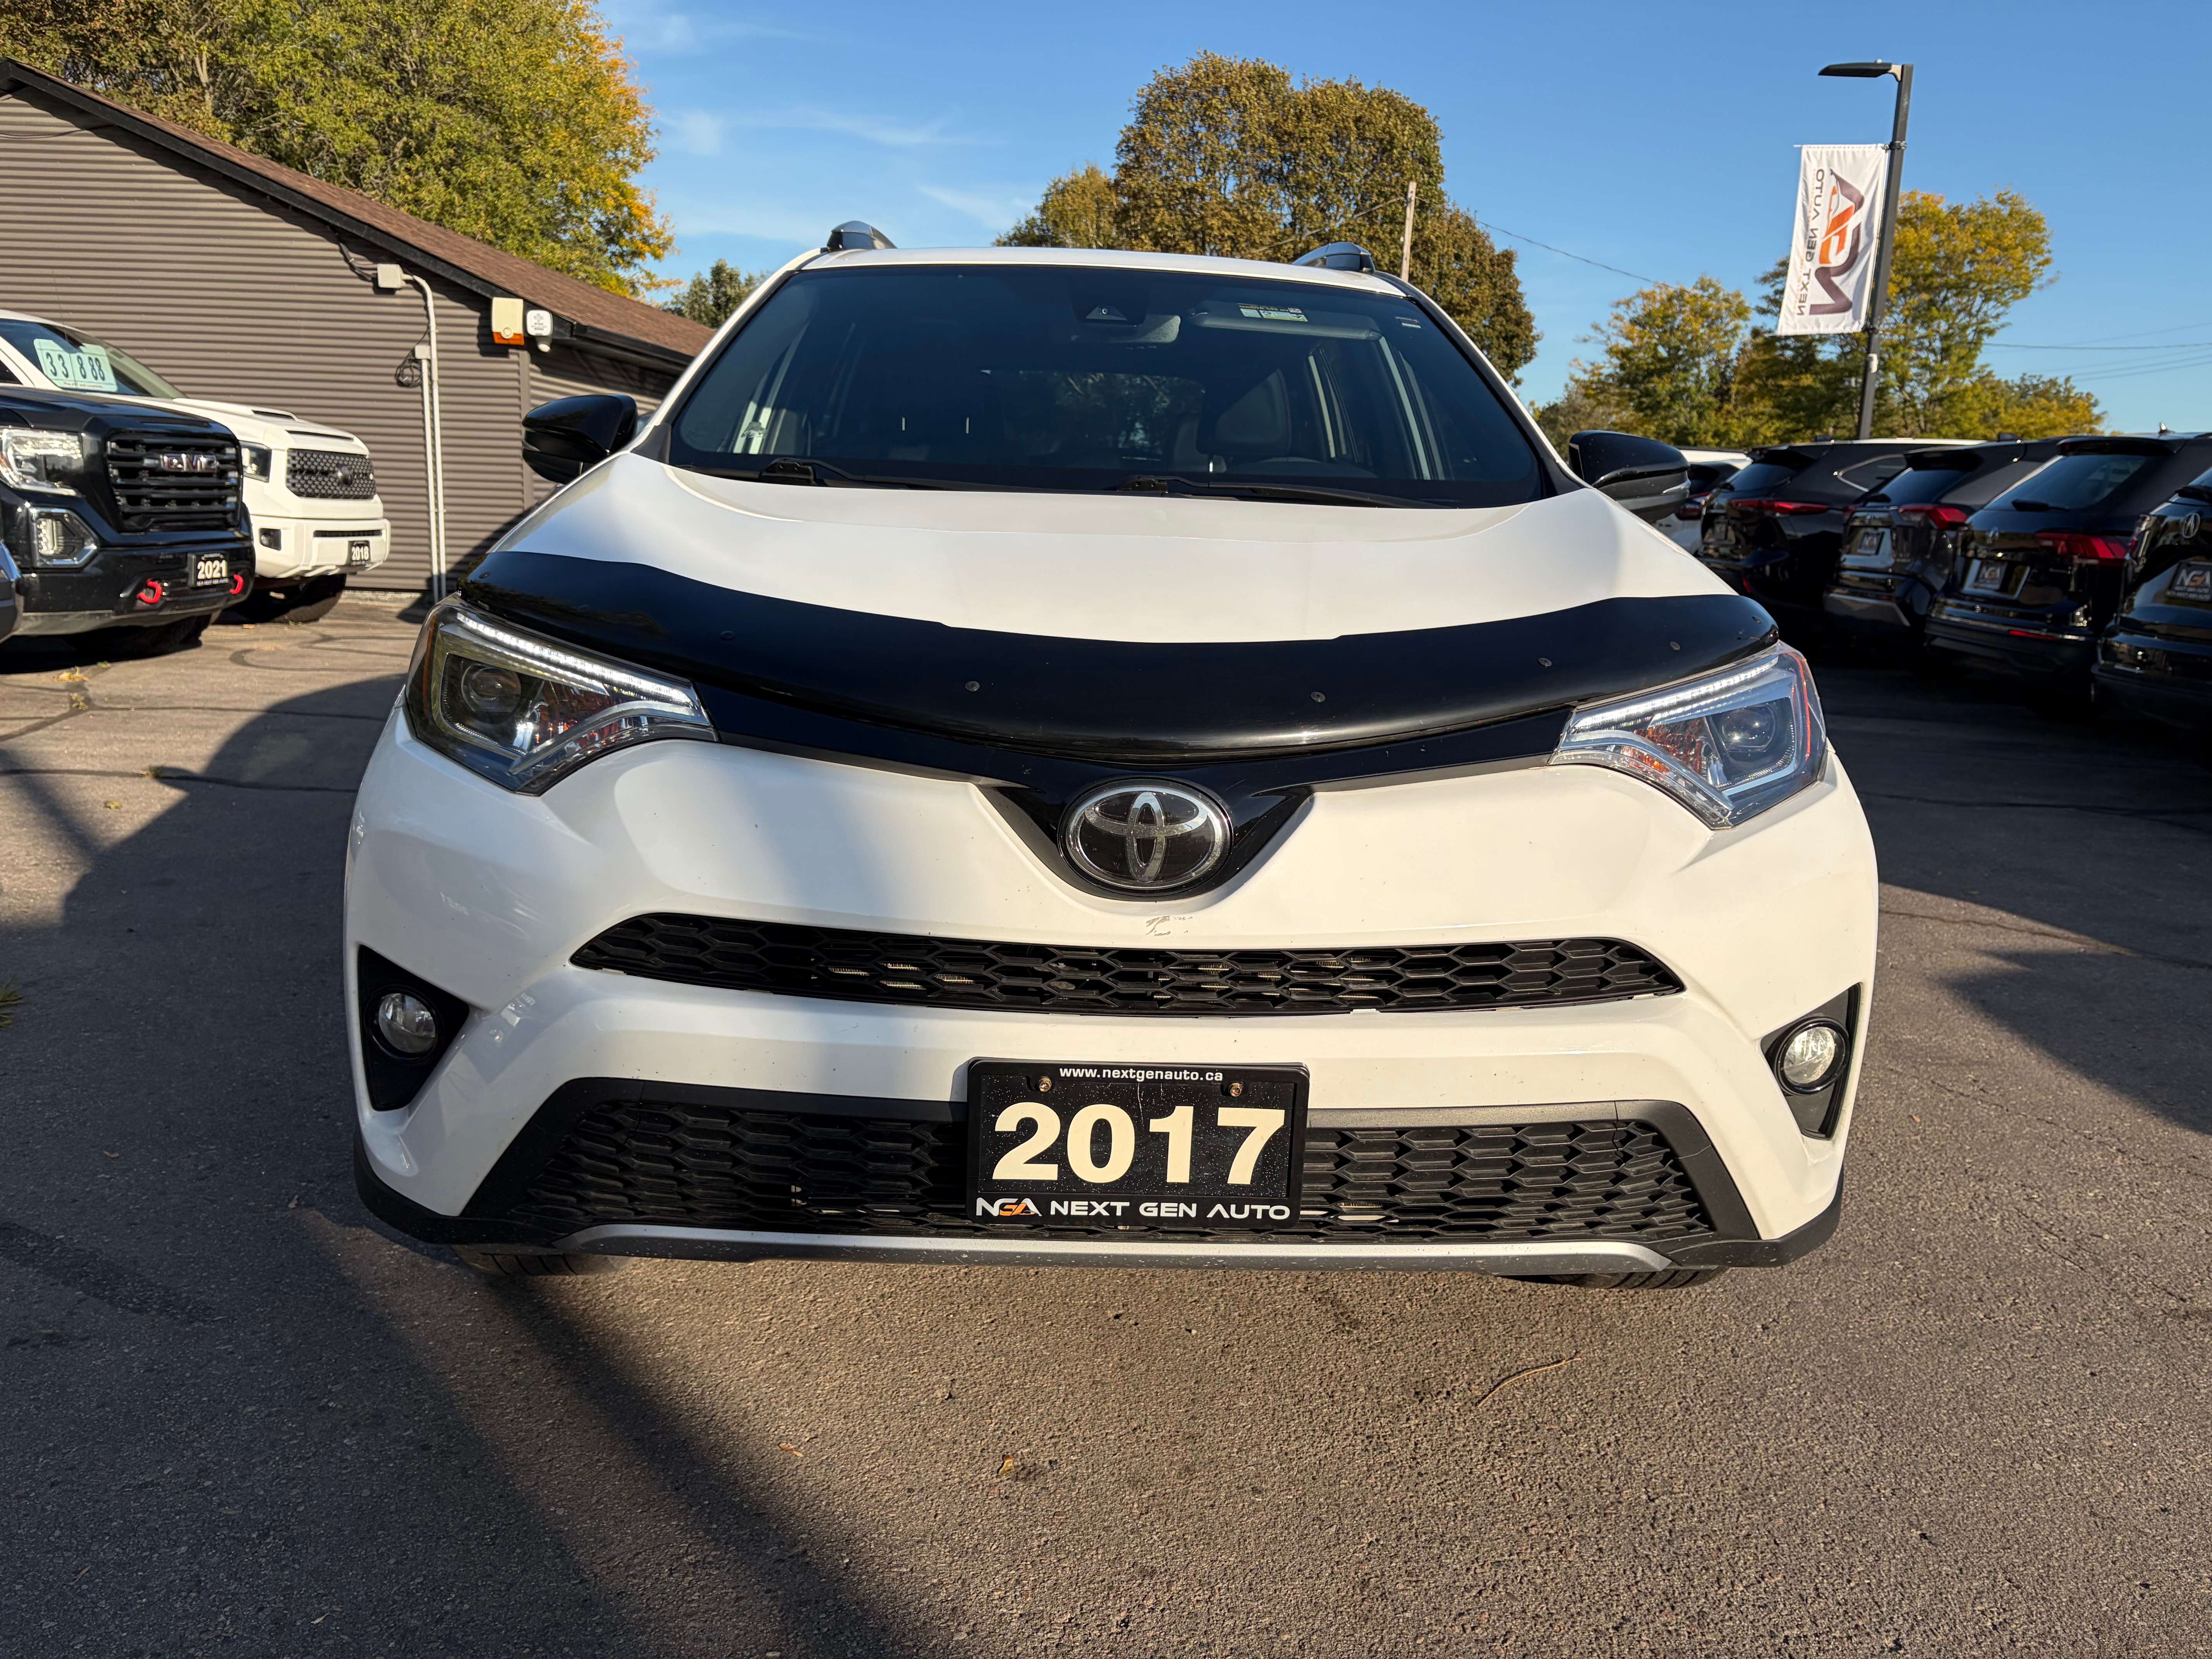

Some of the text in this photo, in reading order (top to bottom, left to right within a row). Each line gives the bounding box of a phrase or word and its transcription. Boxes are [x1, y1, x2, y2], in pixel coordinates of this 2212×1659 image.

[160, 453, 217, 471] GMC
[352, 546, 369, 560] 2018
[197, 560, 228, 579] 2021
[1059, 1068, 1223, 1082] www.nextgenauto.ca
[992, 1102, 1286, 1185] 2017
[976, 1197, 1290, 1219] NGA NEXT GEN AUTO
